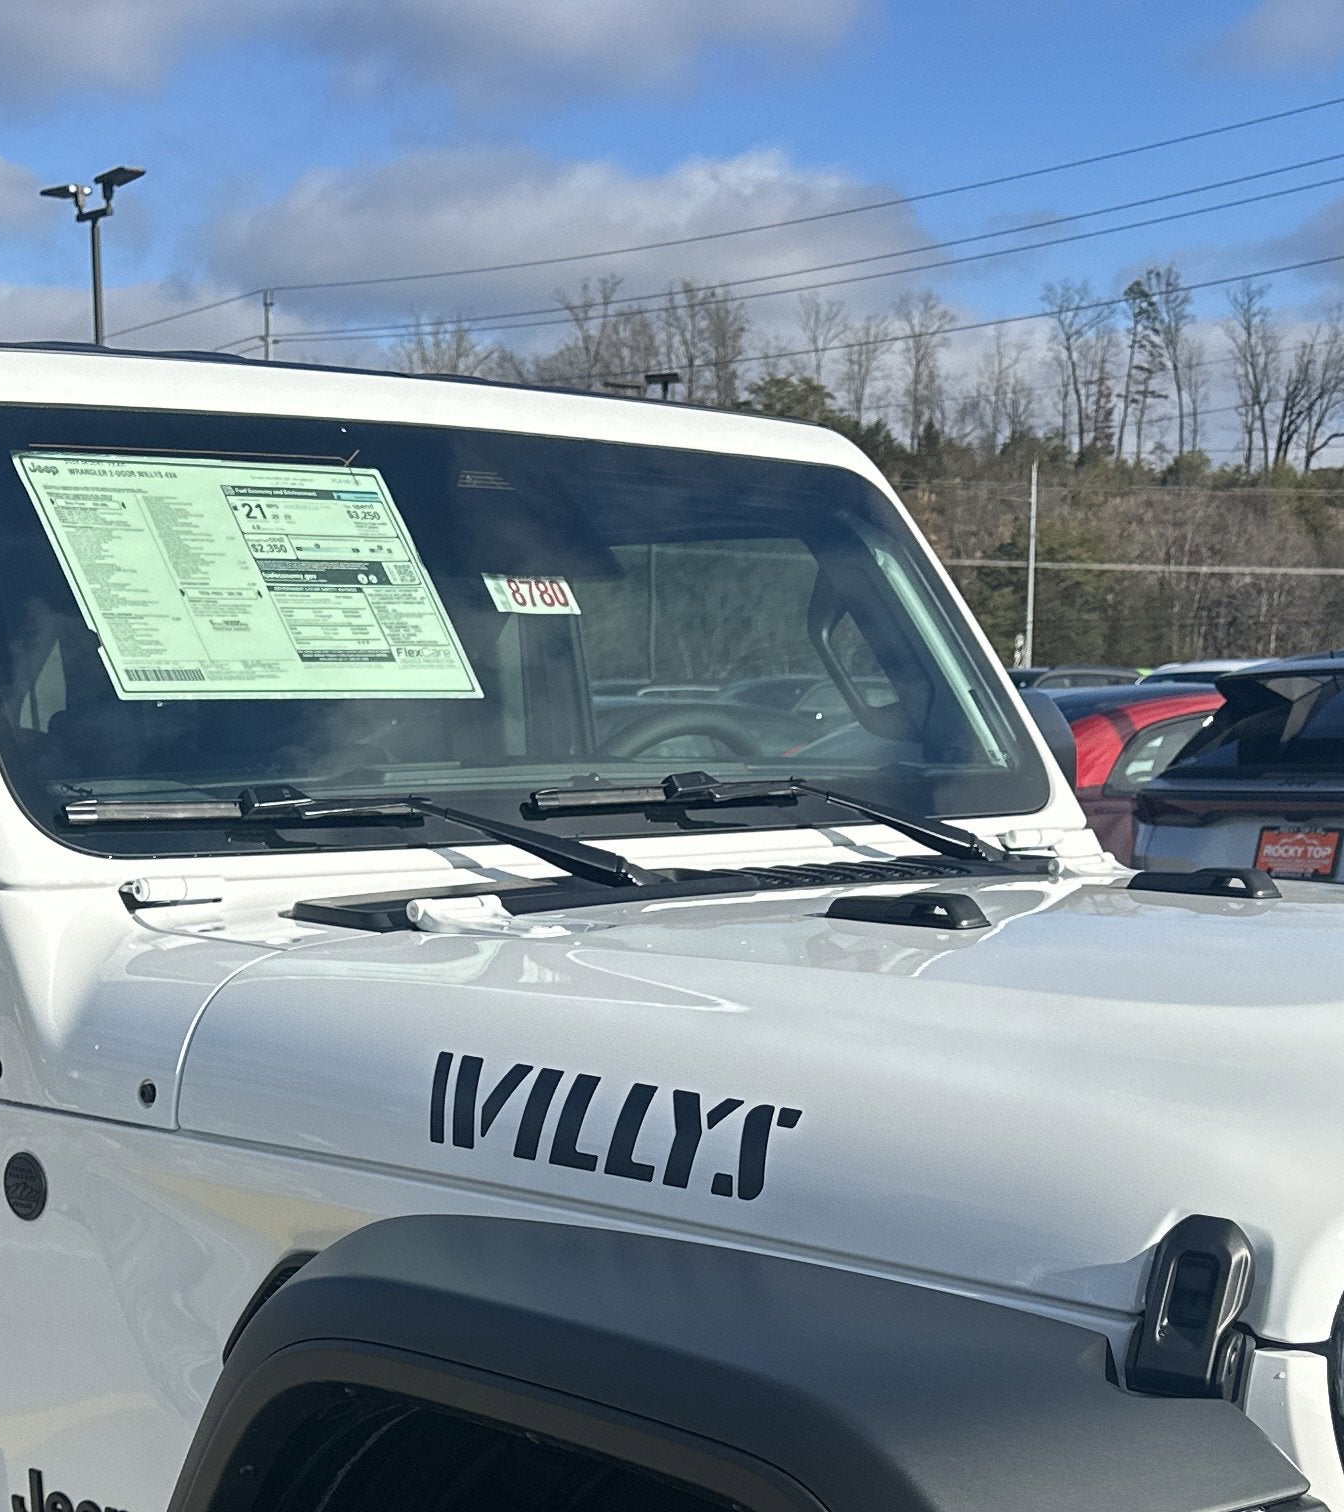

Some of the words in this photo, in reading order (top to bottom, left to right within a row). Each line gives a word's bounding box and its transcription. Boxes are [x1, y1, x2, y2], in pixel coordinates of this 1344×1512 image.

[28, 462, 60, 476] Jeep
[241, 503, 267, 520] 21
[506, 576, 570, 608] 8780
[1263, 844, 1304, 858] ROCKY
[1306, 845, 1332, 859] TOP
[430, 1051, 802, 1200] WILLYS
